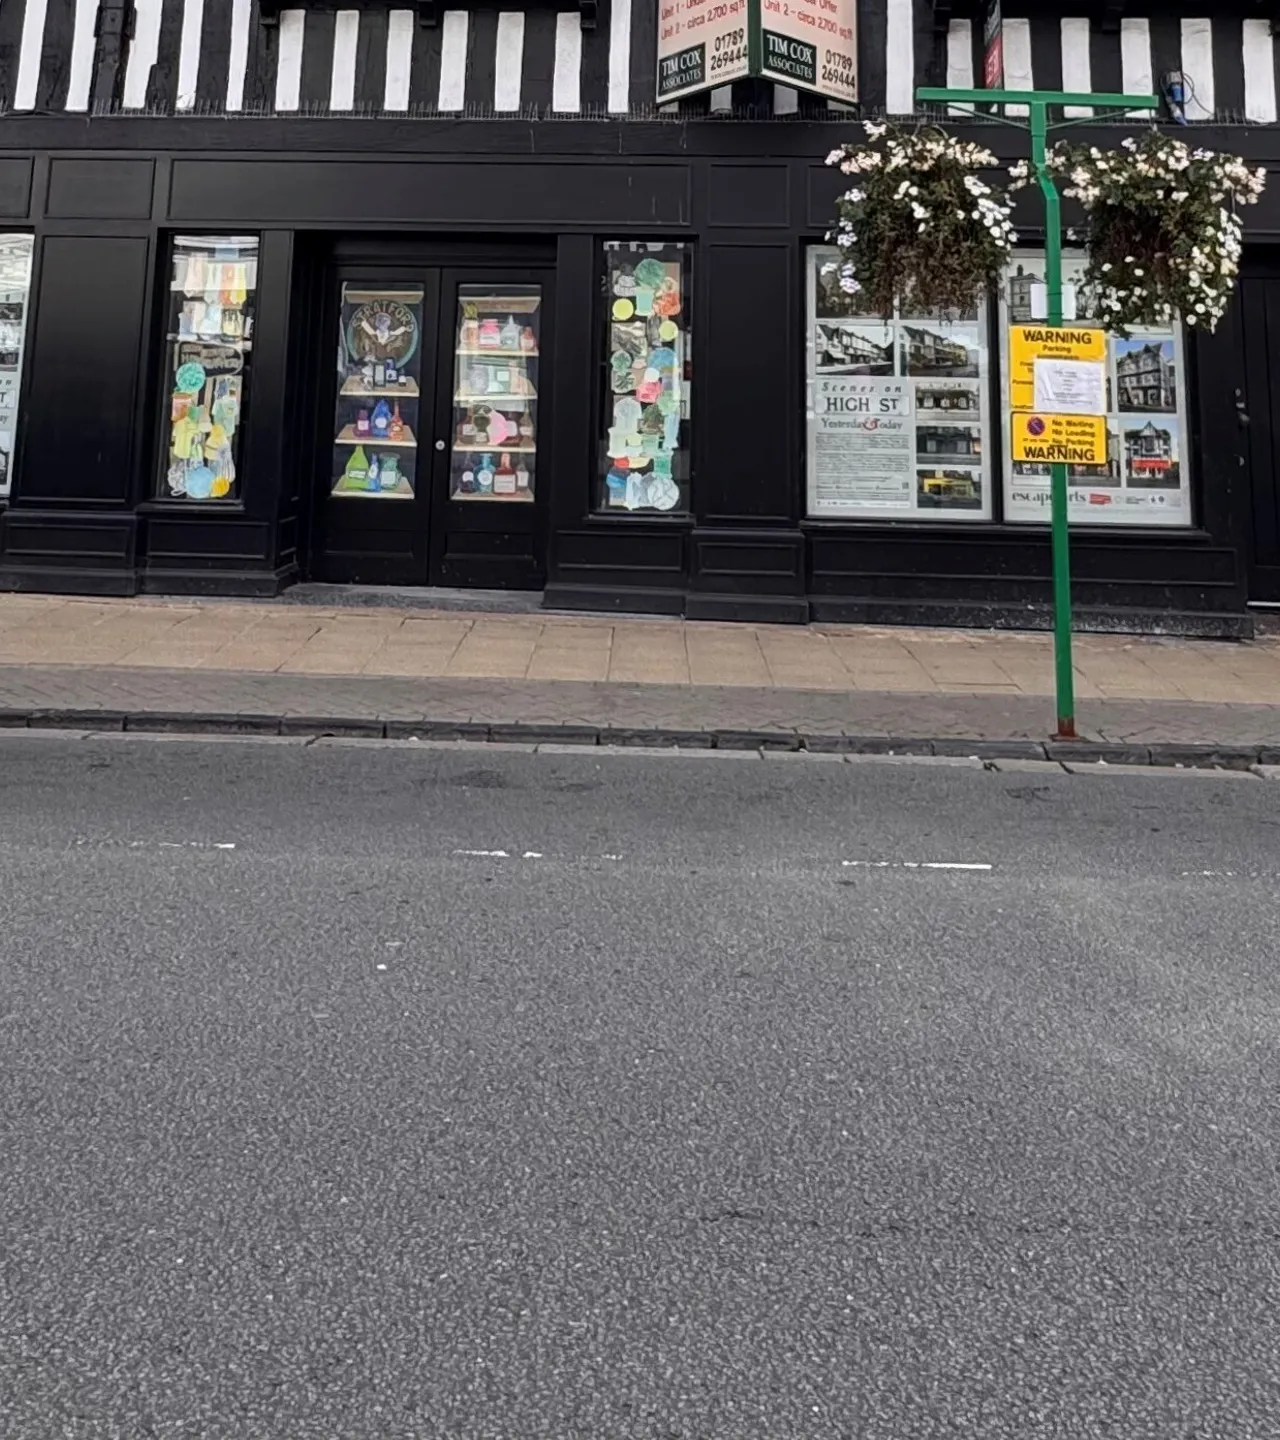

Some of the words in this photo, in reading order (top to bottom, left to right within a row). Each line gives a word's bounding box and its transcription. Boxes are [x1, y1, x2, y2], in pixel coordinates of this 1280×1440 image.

[661, 6, 674, 21] Unit
[783, 3, 789, 16] 2
[797, 10, 816, 27] circa
[661, 26, 673, 41] Unit
[675, 22, 681, 34] 2
[687, 15, 705, 30] circa
[714, 28, 744, 52] 01789
[767, 34, 788, 56] TIM
[790, 42, 813, 64] COX
[662, 57, 679, 76] TIM
[680, 49, 701, 69] COX
[710, 44, 748, 71] 269444
[768, 54, 813, 79] ASSOCIATES
[825, 49, 852, 72] 01789
[662, 68, 701, 91] ASSOCIATES
[822, 65, 855, 89] 269444
[1023, 329, 1092, 344] WARNING
[1042, 344, 1072, 354] Parking
[821, 381, 875, 393] Scenes
[825, 397, 870, 412] HIGH
[880, 398, 899, 412] ST
[1052, 419, 1063, 427] No
[1065, 420, 1094, 429] Waiting
[1065, 430, 1095, 438] Loading
[1023, 446, 1095, 461] WARNING
[1065, 438, 1094, 447] Parking
